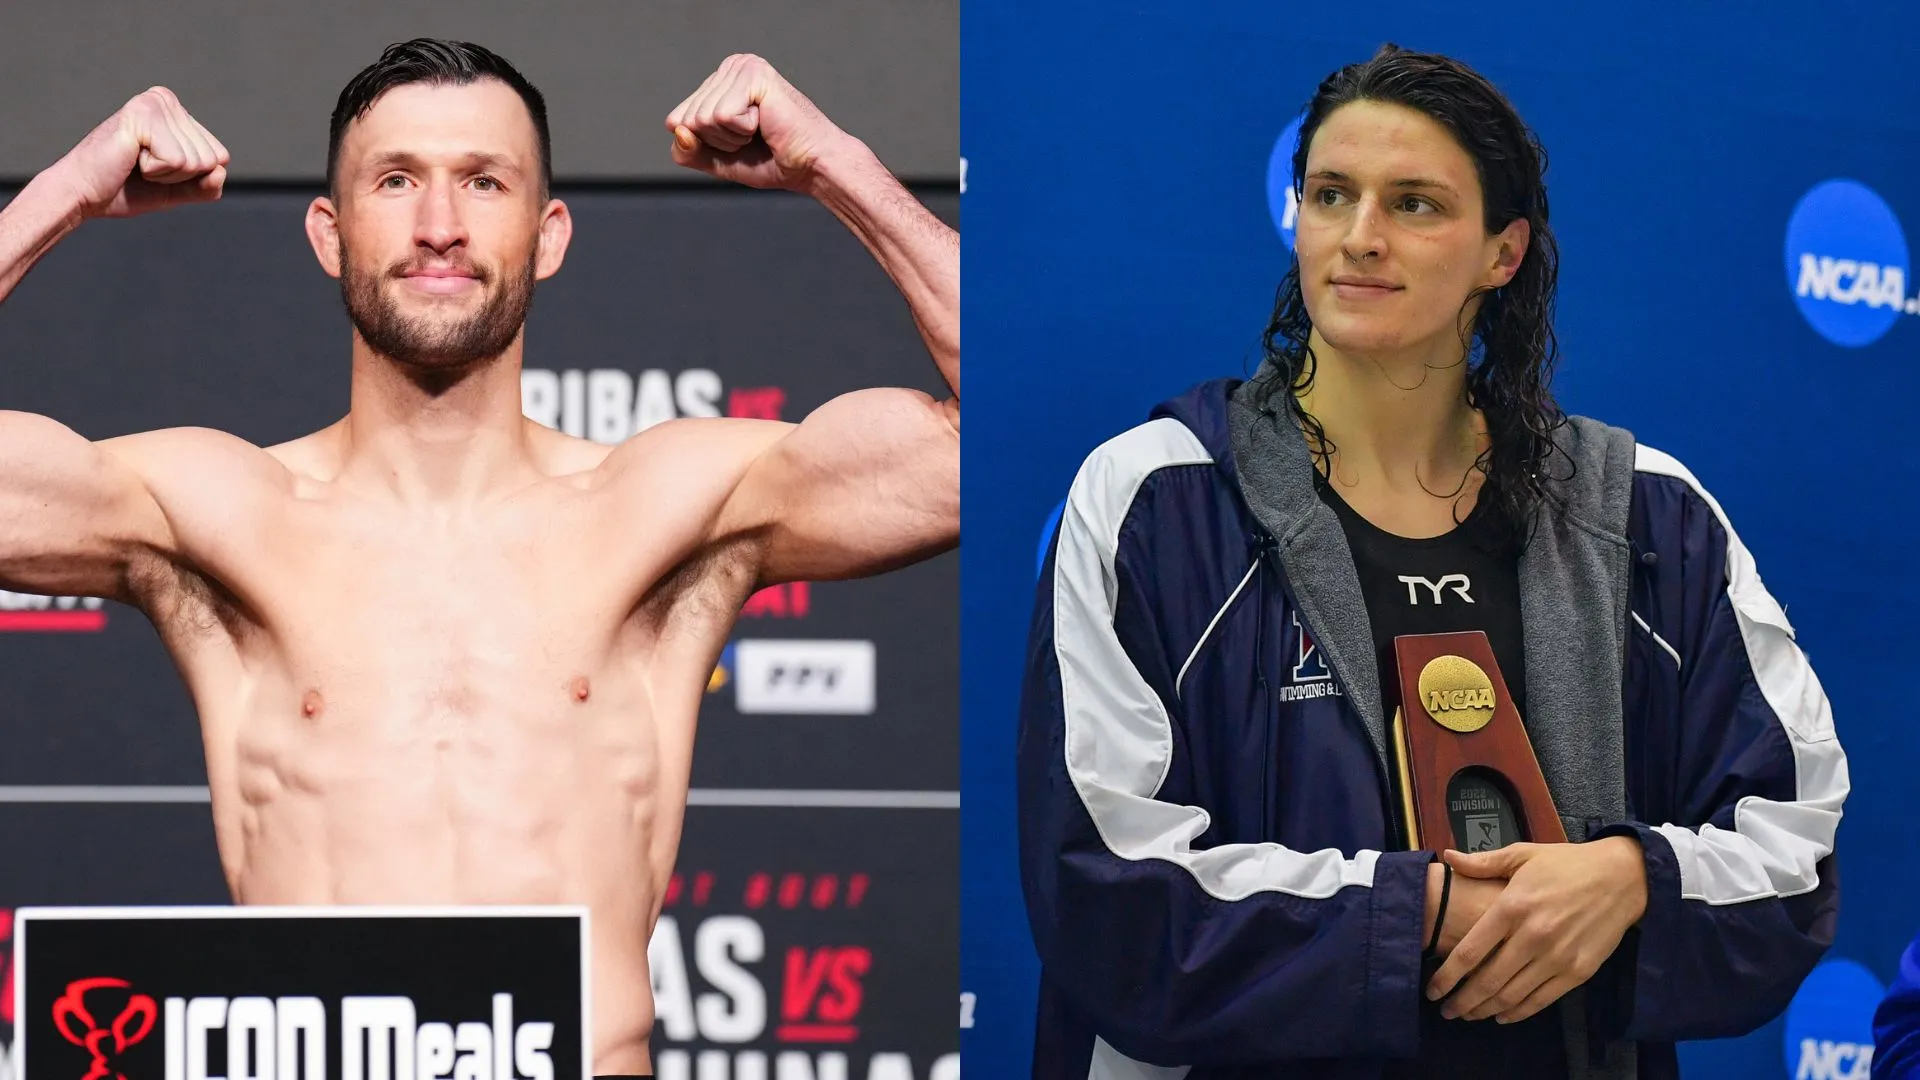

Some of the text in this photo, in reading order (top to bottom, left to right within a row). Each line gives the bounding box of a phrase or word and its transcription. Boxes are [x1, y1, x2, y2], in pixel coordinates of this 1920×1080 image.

[1797, 253, 1920, 317] NCAA.
[1397, 573, 1476, 605] TYR
[1280, 682, 1326, 702] WIMMING
[1429, 688, 1496, 712] NCAA
[1452, 799, 1495, 812] DIVISION
[647, 914, 872, 1043] AS VS
[164, 992, 555, 1080] ICON Meals
[1796, 1037, 1876, 1080] NCA
